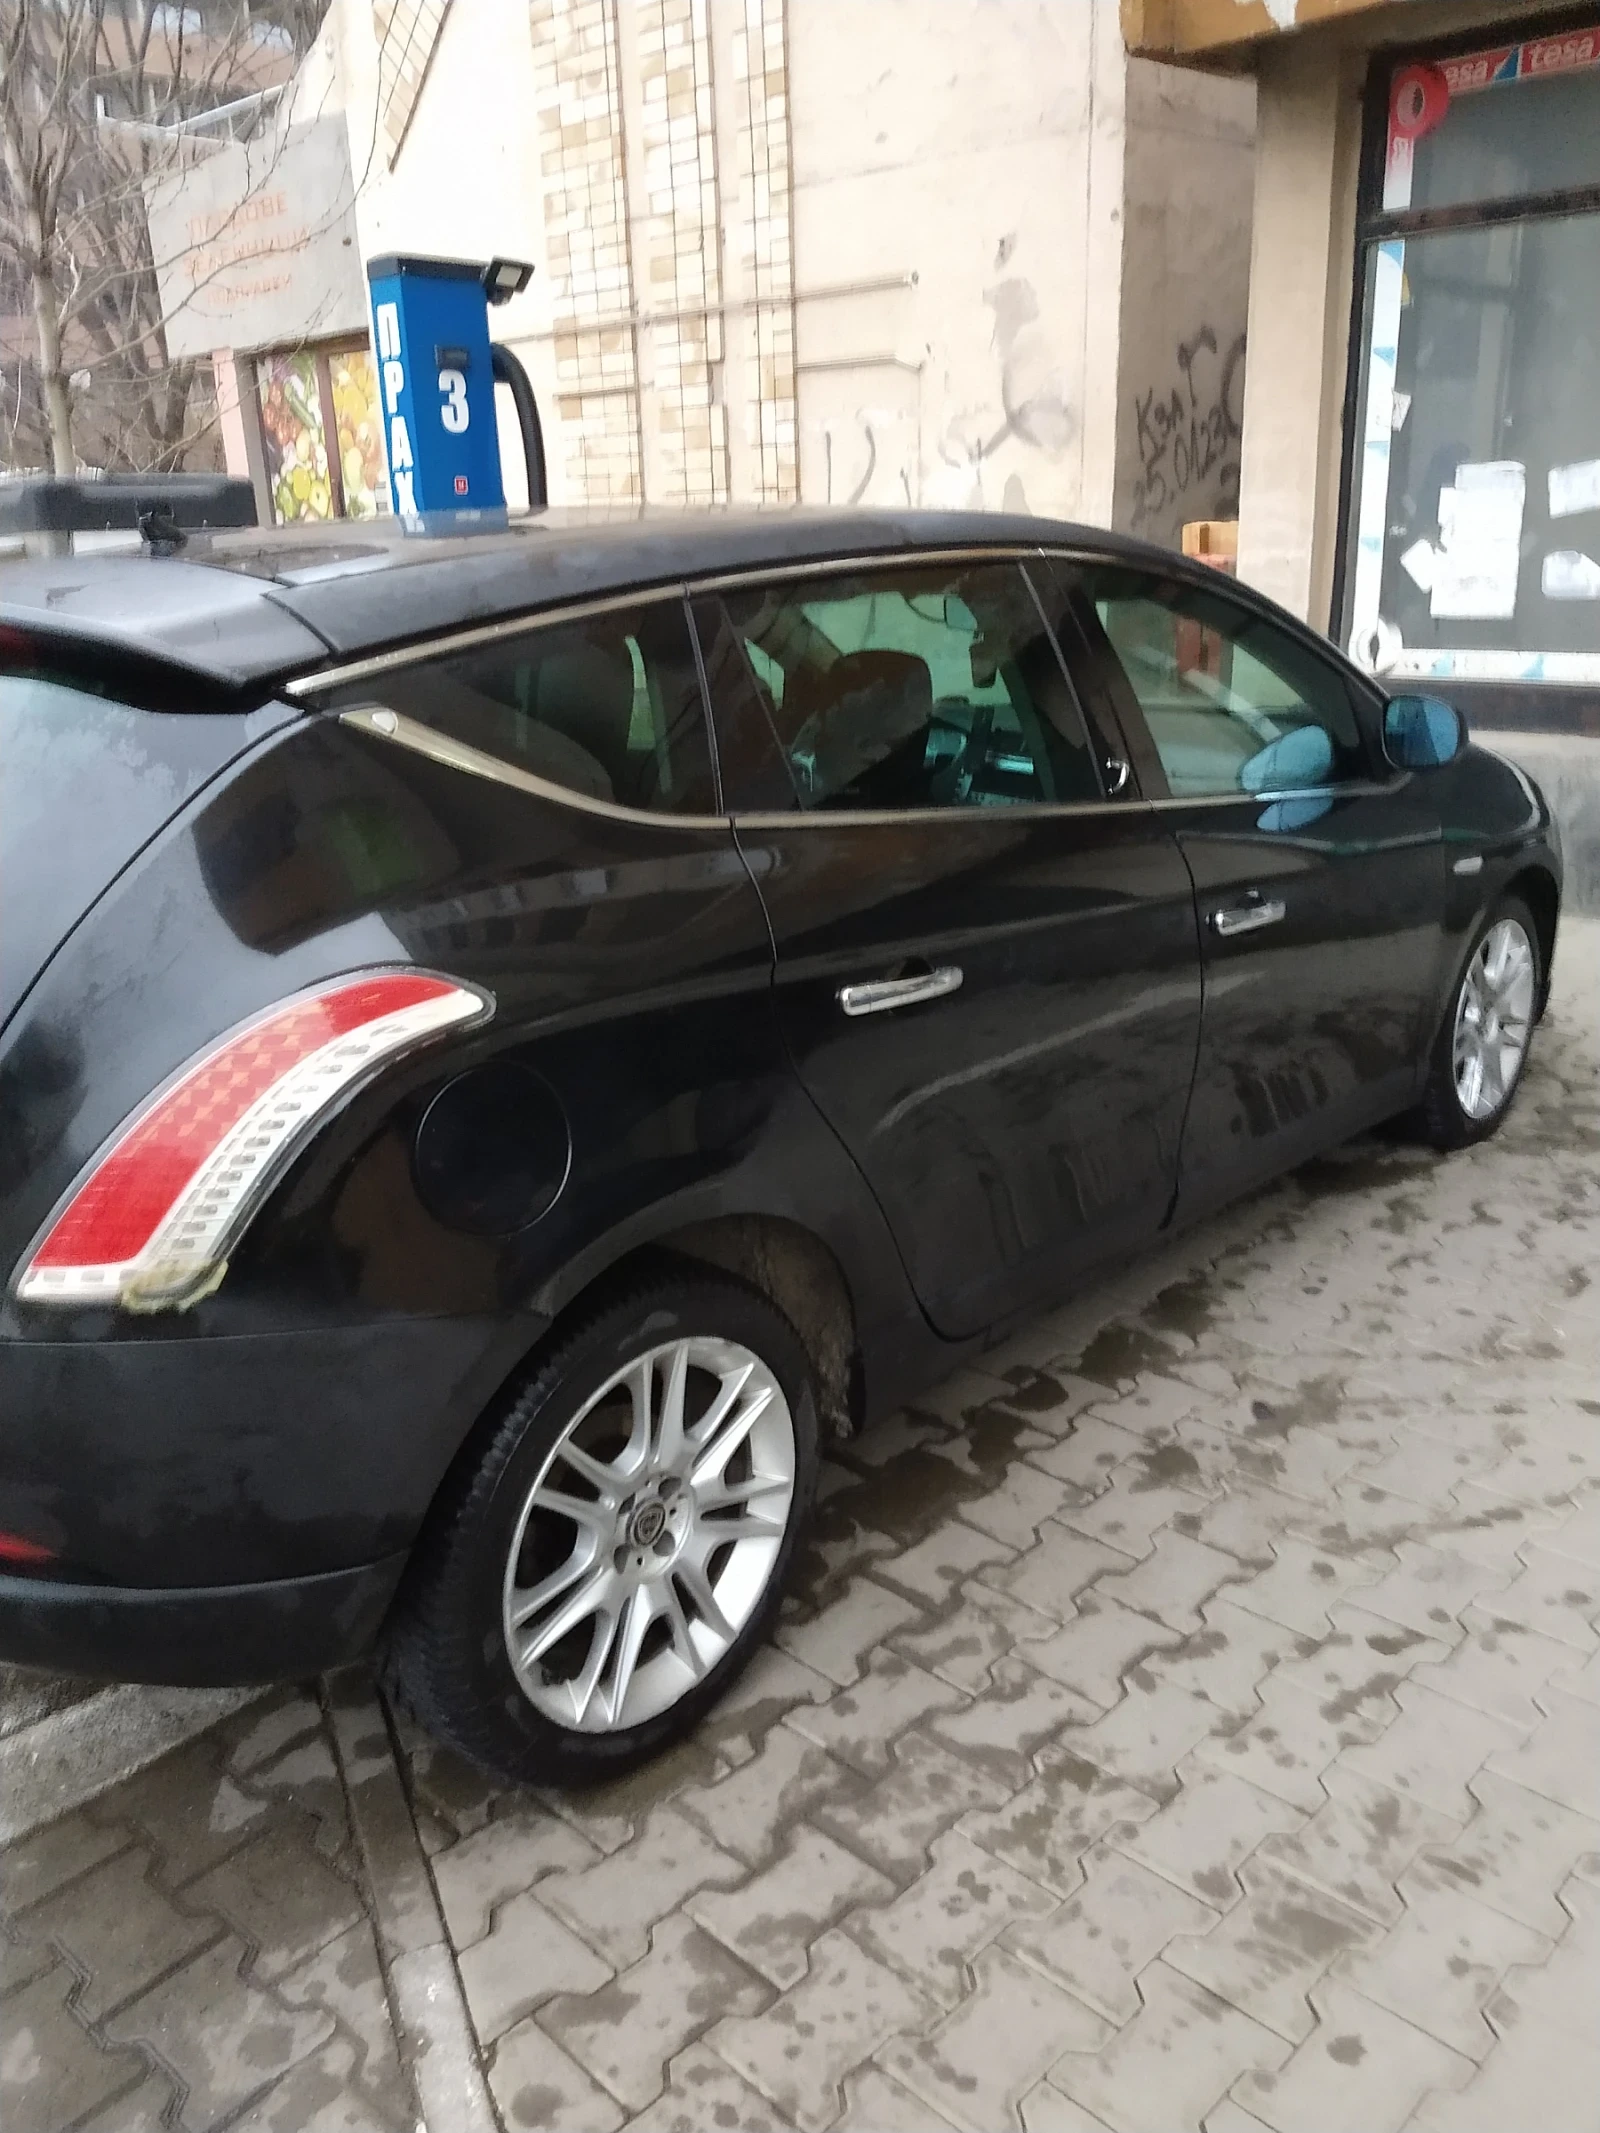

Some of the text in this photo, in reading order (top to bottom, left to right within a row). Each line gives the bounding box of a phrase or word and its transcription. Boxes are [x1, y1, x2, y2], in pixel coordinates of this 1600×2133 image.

[1528, 36, 1595, 70] tesa
[1445, 59, 1489, 89] esa
[438, 368, 470, 434] 3
